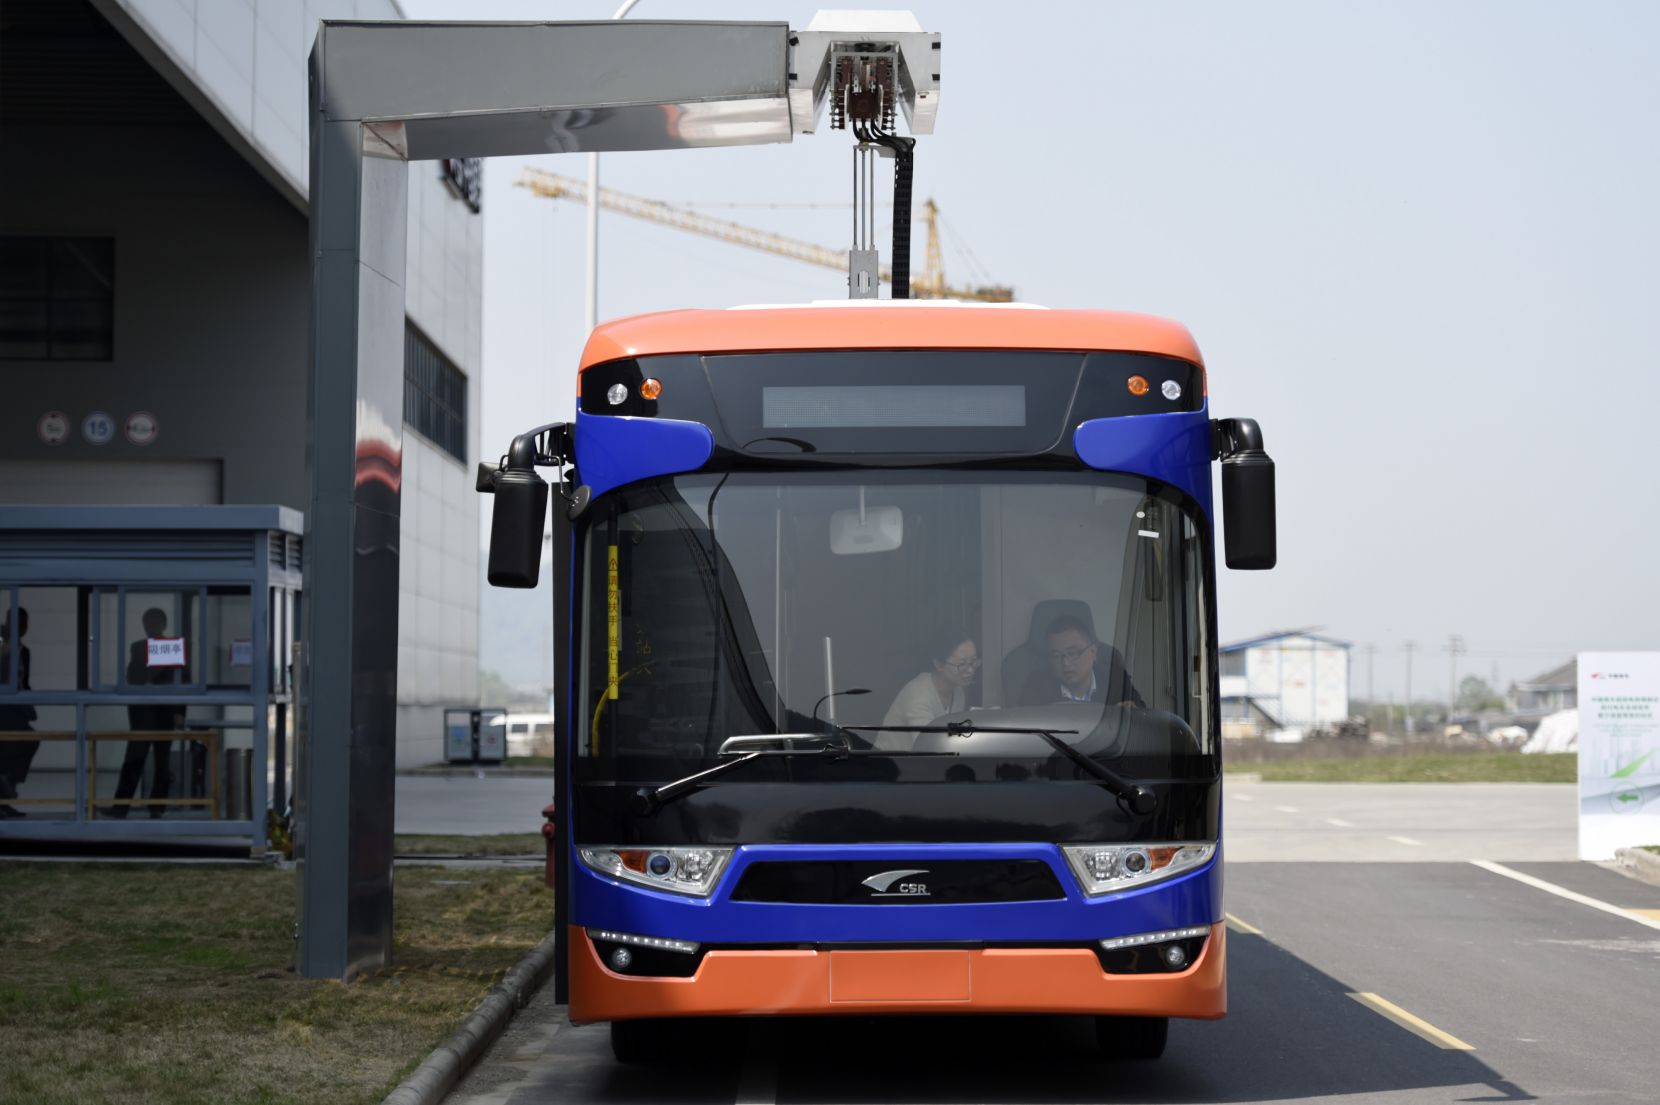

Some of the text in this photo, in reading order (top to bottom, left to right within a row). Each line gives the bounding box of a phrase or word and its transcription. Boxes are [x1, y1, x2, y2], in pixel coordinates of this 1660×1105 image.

[149, 643, 182, 656] 吸烟亭
[899, 883, 927, 895] CSR
